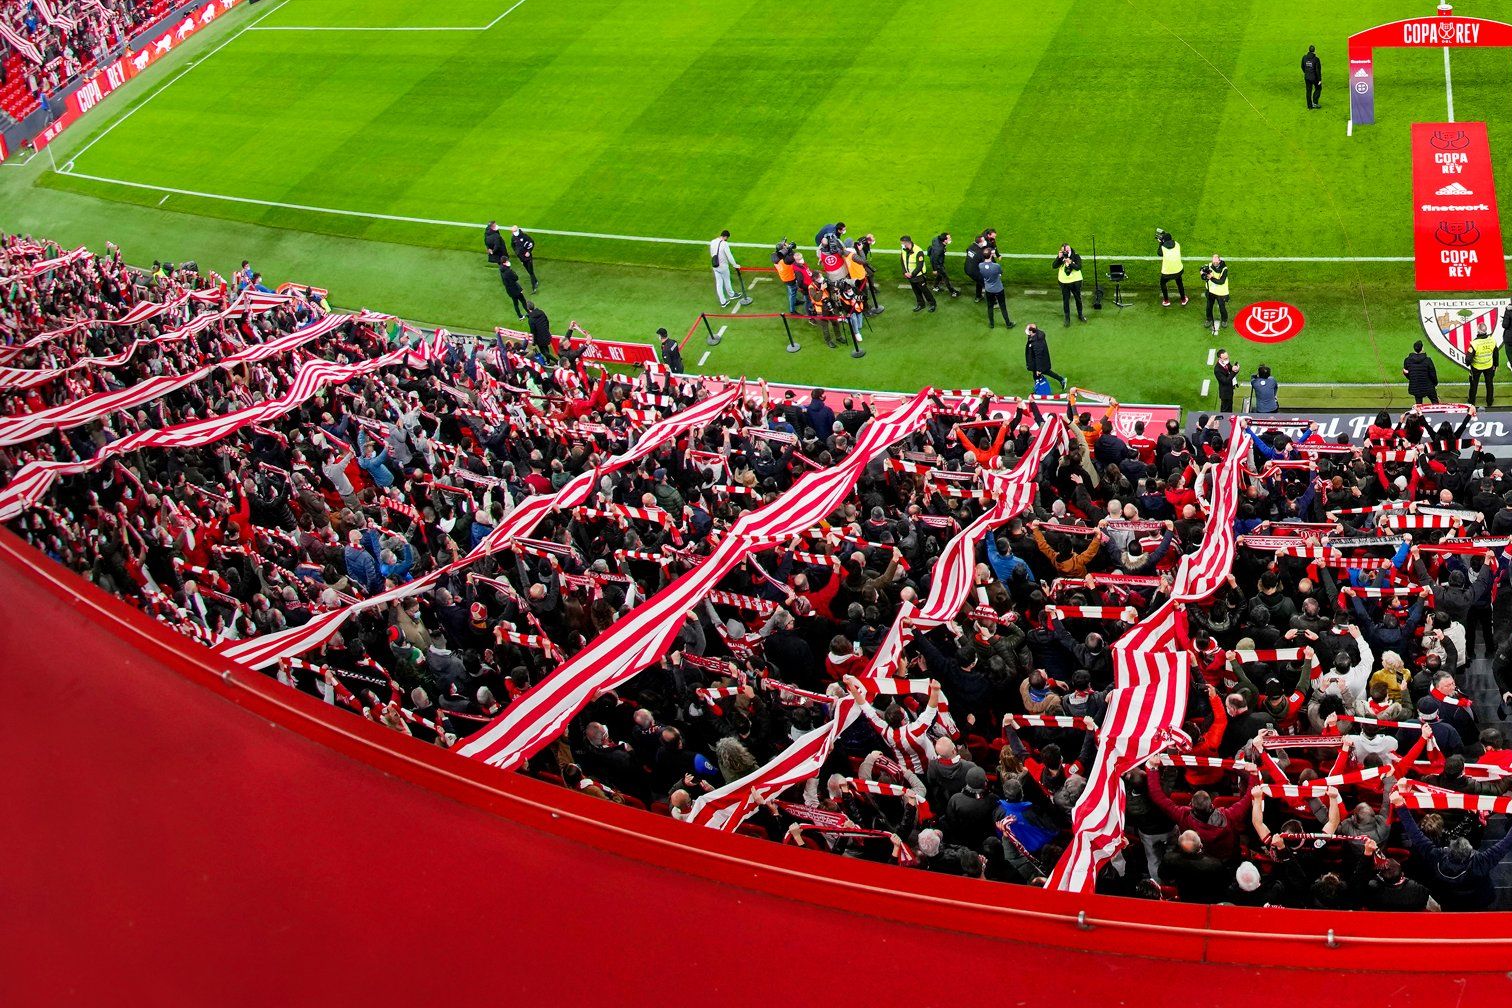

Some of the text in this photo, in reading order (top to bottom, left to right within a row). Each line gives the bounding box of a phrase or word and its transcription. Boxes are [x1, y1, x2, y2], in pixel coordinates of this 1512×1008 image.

[1403, 23, 1480, 44] COPA REY
[76, 59, 126, 113] COPA REY
[1434, 152, 1469, 164] COPA
[1441, 165, 1463, 174] REY
[1421, 204, 1490, 212] finetwork
[1440, 249, 1479, 264] COPA
[1448, 266, 1472, 278] REY
[608, 345, 626, 361] REY
